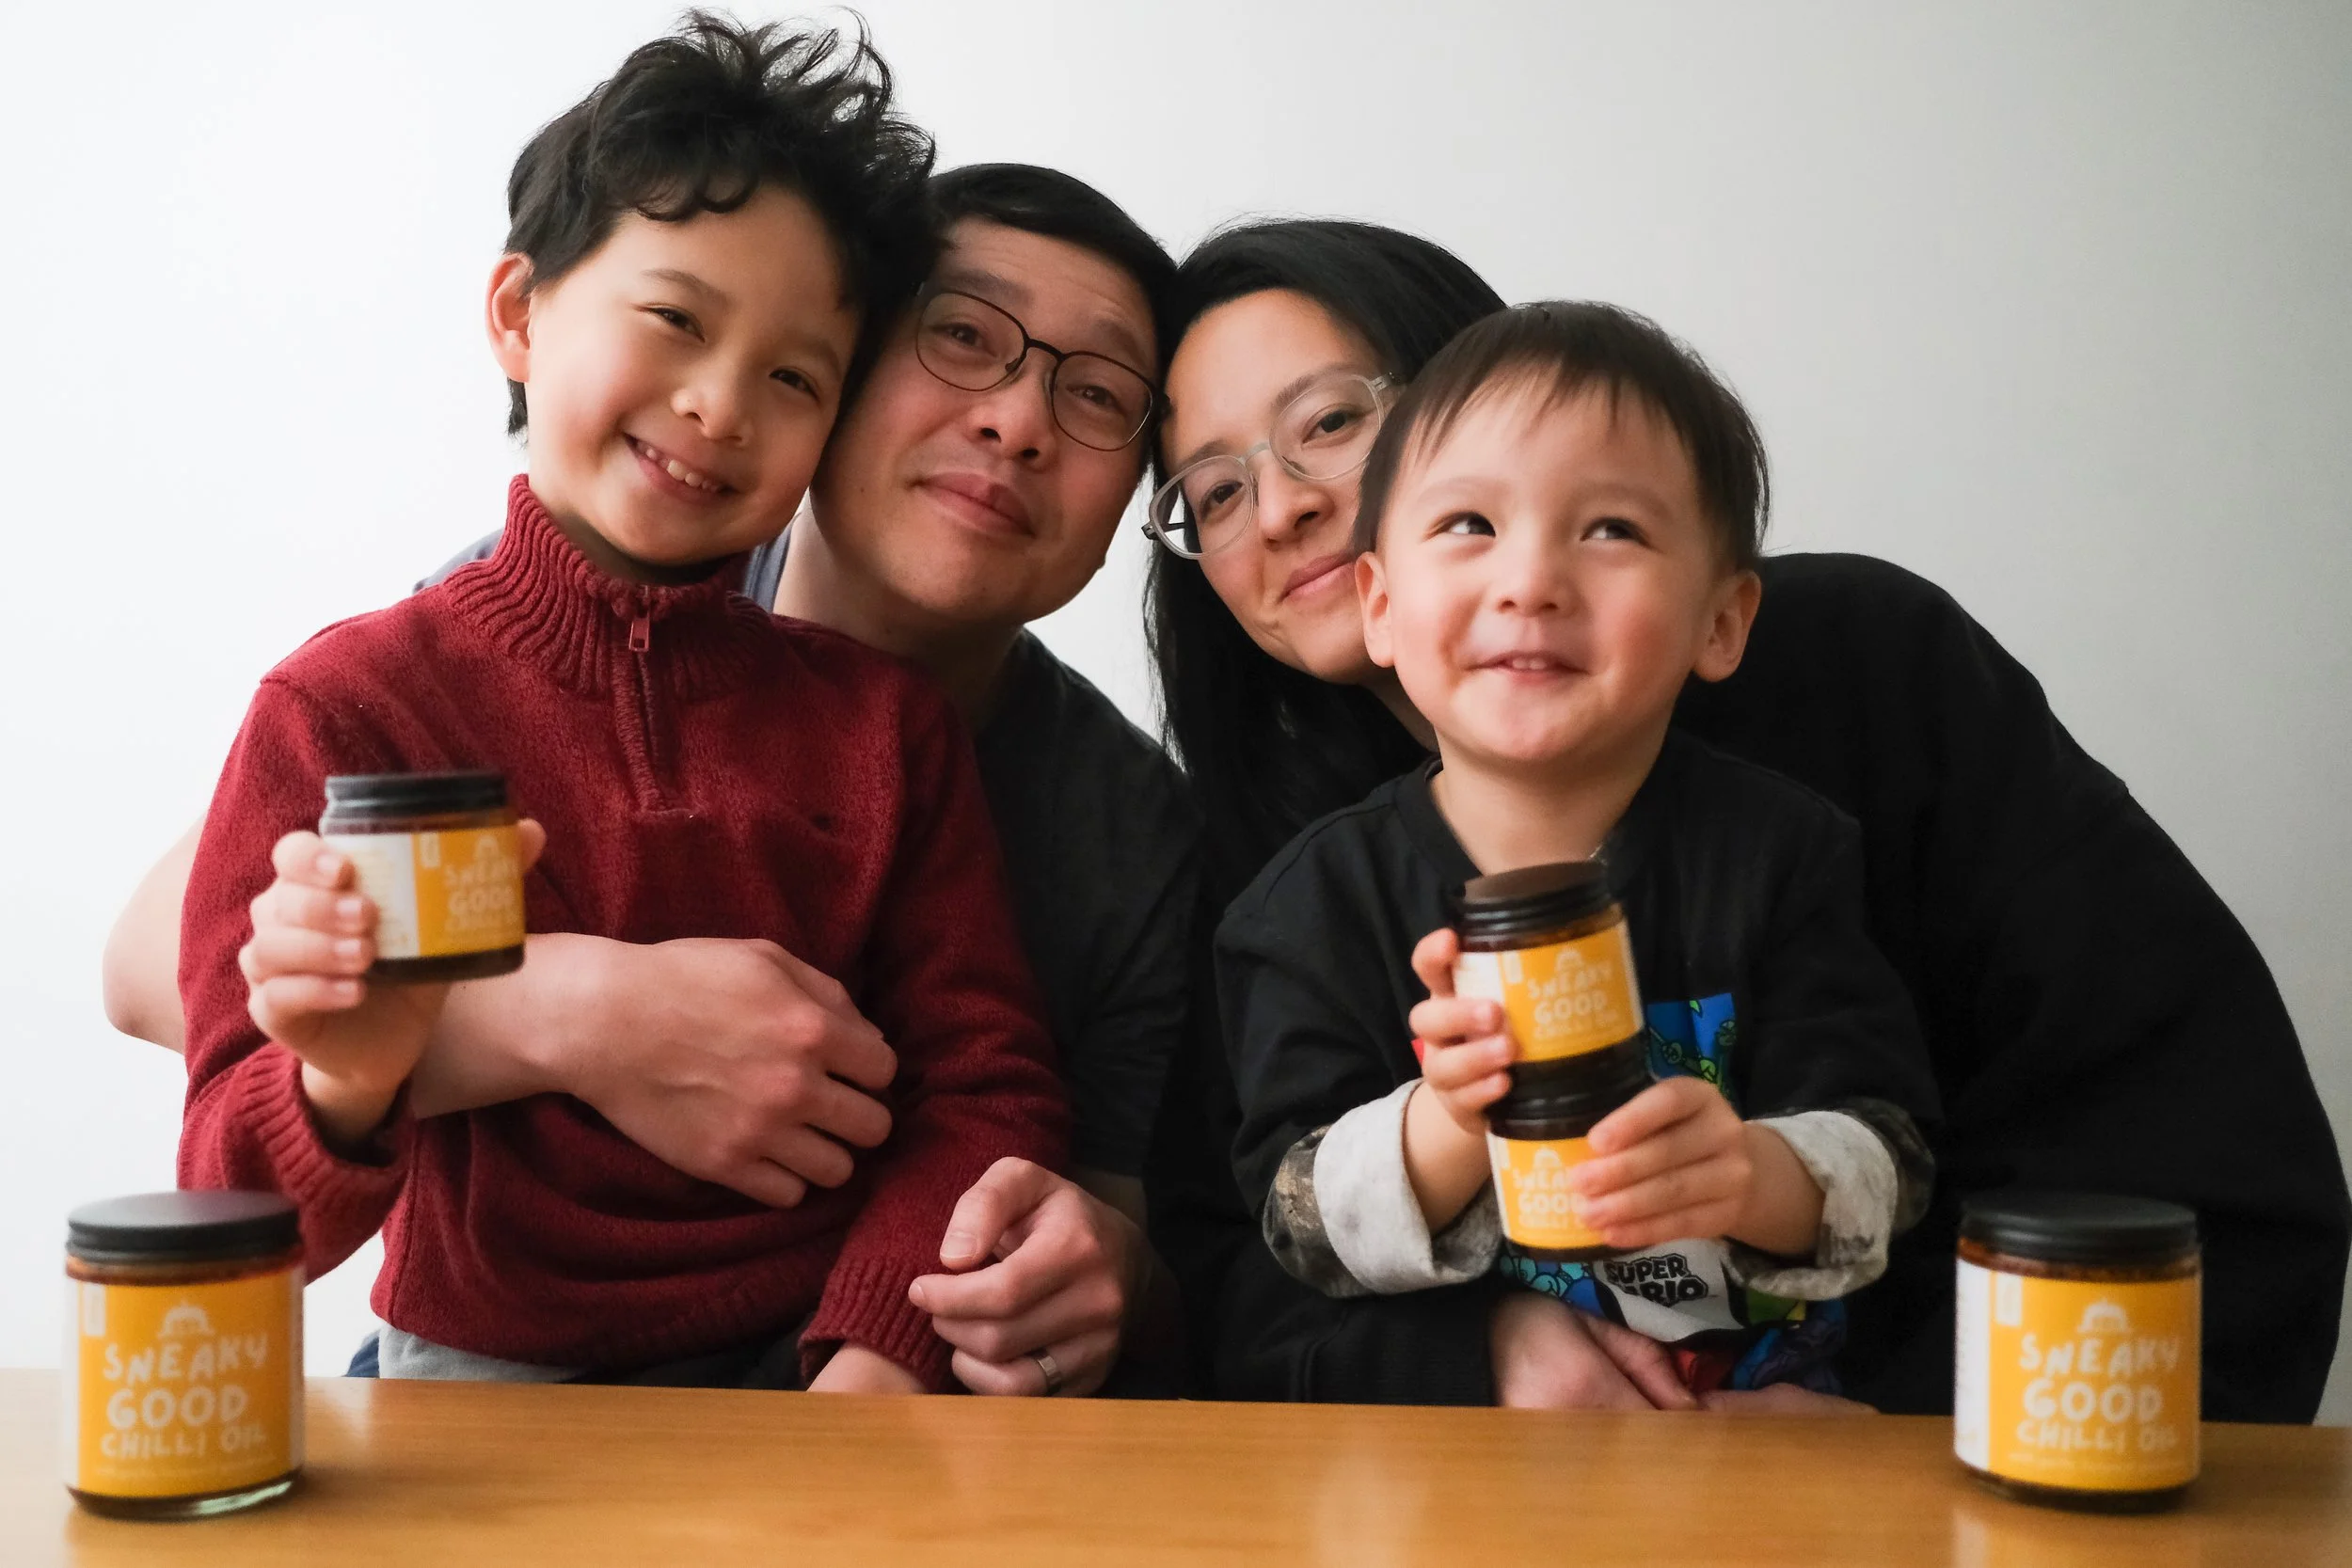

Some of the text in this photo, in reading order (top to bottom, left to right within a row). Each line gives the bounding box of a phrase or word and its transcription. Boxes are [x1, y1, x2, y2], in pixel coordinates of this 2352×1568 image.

[1534, 990, 1607, 1025] GOOD
[1513, 1167, 1572, 1192] SNEA
[1603, 1255, 1688, 1286] SUPER
[102, 1331, 268, 1386] SNEAKY
[2018, 1332, 2180, 1379] SNEAKY
[106, 1385, 248, 1430] GOOD
[2023, 1377, 2163, 1424] GOOD
[100, 1430, 207, 1460] CHILLI
[2016, 1419, 2126, 1454] CHILLI
